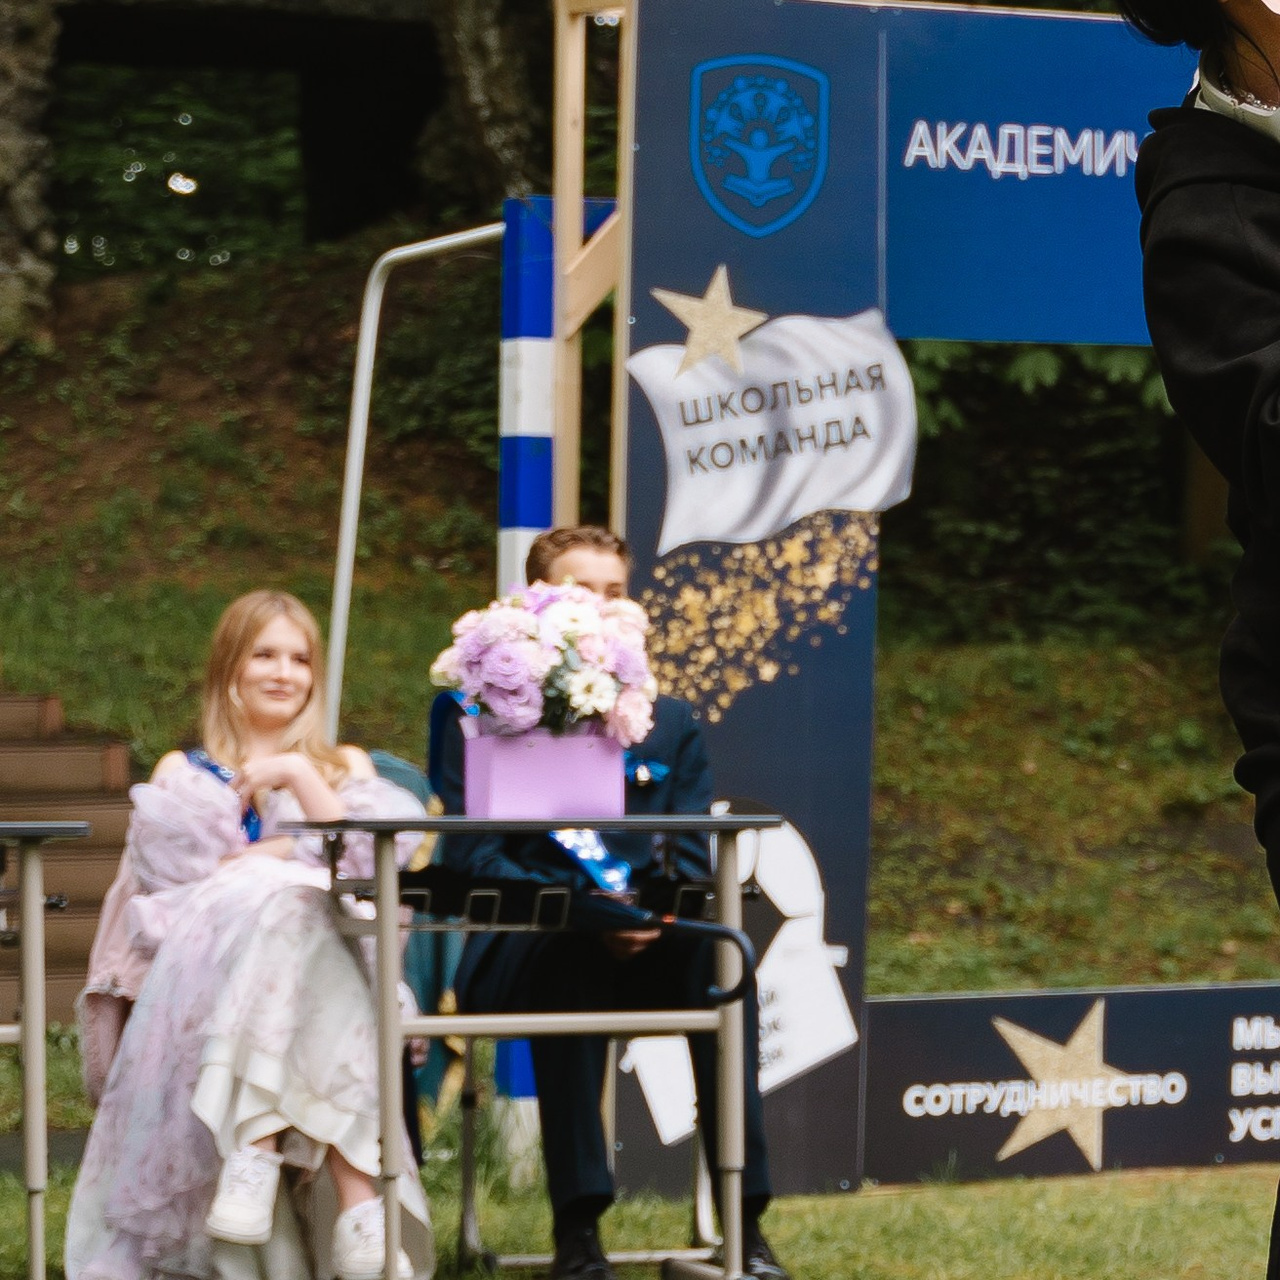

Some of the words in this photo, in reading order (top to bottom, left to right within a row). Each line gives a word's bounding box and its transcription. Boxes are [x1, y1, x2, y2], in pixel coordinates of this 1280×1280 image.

[679, 363, 887, 427] ШКОЛЬНАЯ
[686, 416, 871, 475] КОМАНДА
[902, 1071, 1188, 1118] СОТРУДНИЧЕСТВО
